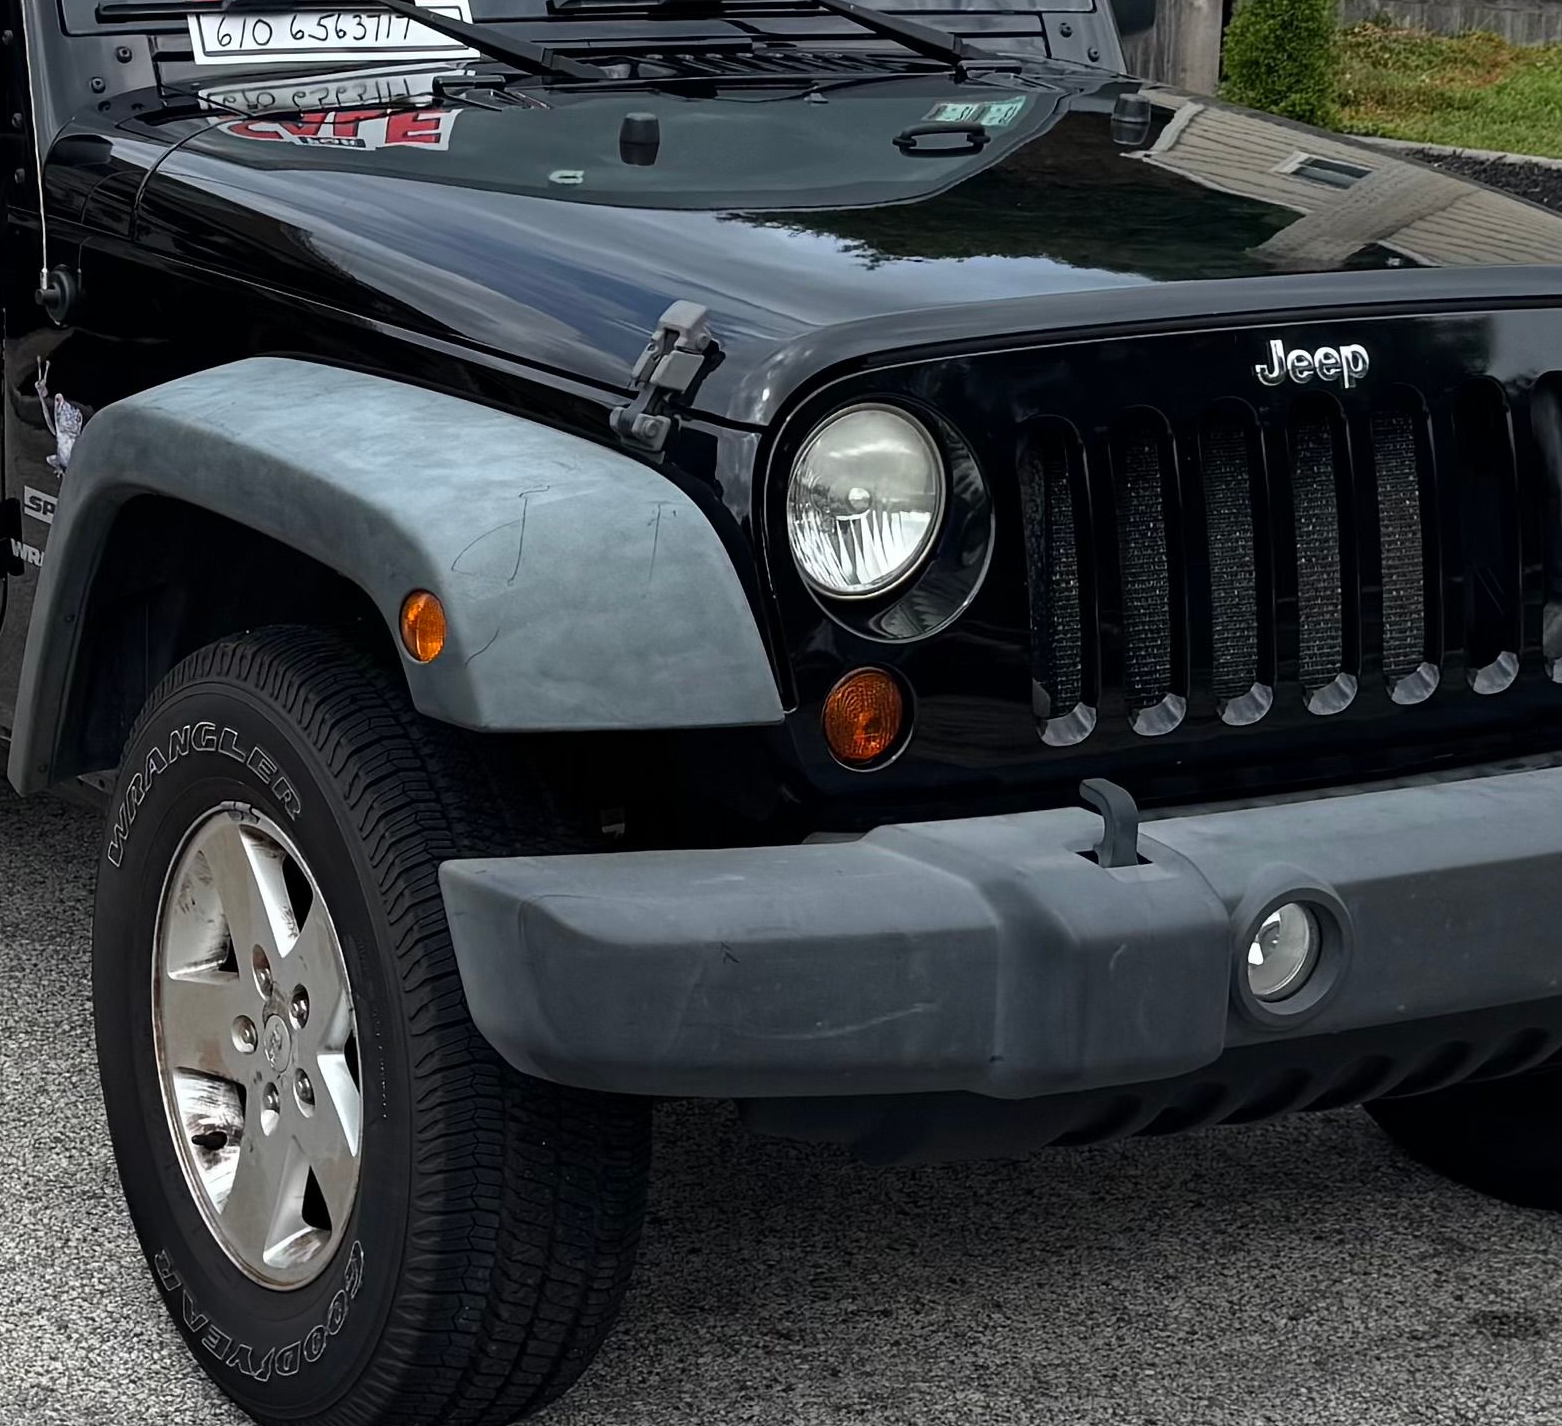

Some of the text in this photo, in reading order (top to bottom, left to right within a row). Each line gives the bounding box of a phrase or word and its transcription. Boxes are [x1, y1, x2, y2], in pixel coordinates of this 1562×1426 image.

[217, 13, 274, 49] 610
[1255, 339, 1370, 389] Jeep
[30, 495, 55, 515] SP
[107, 721, 302, 868] WRANGLER
[153, 1239, 365, 1383] GOODYEAR
